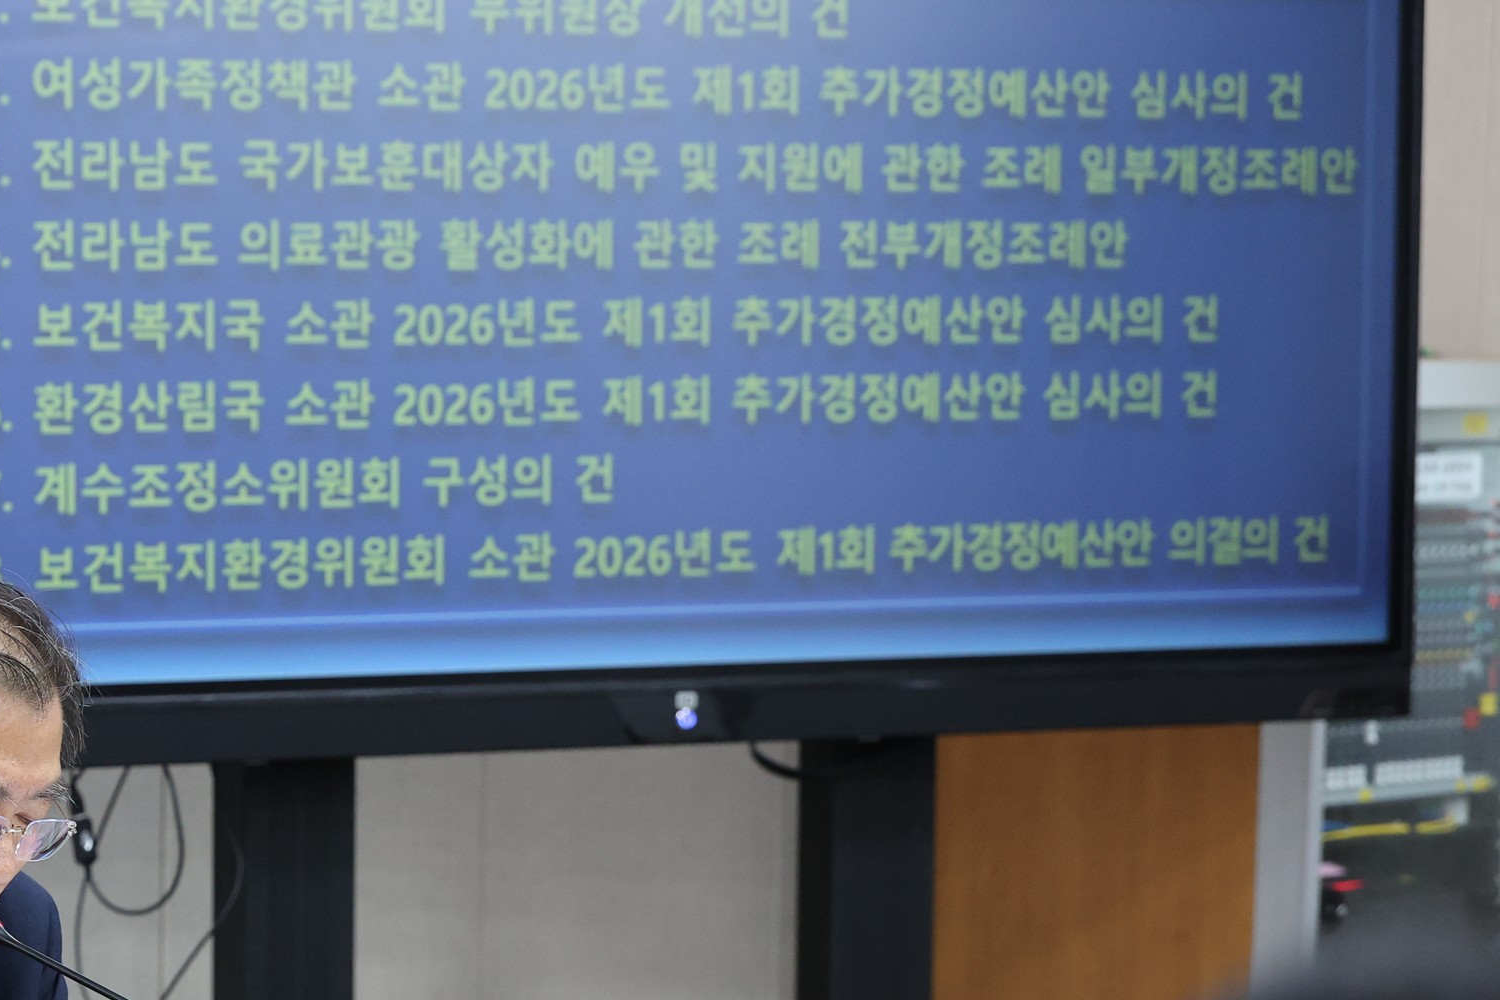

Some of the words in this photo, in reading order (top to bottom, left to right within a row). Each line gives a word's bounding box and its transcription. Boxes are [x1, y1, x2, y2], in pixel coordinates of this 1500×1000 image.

[814, 0, 849, 38] 건
[32, 58, 355, 111] 여성가족정책관
[380, 63, 465, 111] 소관
[486, 65, 669, 113] 2026년도
[695, 66, 799, 114] 제1회
[822, 67, 1111, 118] 추가경정예산안
[1131, 71, 1249, 120] 심사의
[1267, 73, 1303, 121] 건
[32, 138, 217, 191] 전라남도
[240, 139, 553, 191] 국가보훈대상자
[576, 142, 657, 191] 예우
[680, 143, 716, 192] 및
[740, 143, 863, 193] 지원에
[883, 144, 963, 193] 관한
[984, 145, 1062, 193] 조례
[1081, 145, 1358, 196] 일부개정조례안
[33, 219, 218, 272] 전라남도
[239, 220, 419, 271] 의료관광
[442, 219, 614, 271] 활성화에
[635, 220, 719, 269] 관한
[739, 220, 820, 269] 조례
[841, 220, 1129, 270] 전부개정조례안
[33, 299, 265, 352] 보건복지국
[286, 299, 374, 349] 소관
[394, 298, 582, 347] 2026년도
[604, 297, 711, 348] 제1회
[733, 296, 1025, 346] 추가경정예산안
[1045, 295, 1163, 345] 심사의
[1183, 294, 1219, 344] 건
[33, 379, 265, 436] 환경산림국
[286, 379, 376, 430] 소관
[393, 377, 581, 427] 2026년도
[603, 375, 712, 426] 제1회
[732, 372, 1025, 425] 추가경정예산안
[1044, 371, 1162, 422] 심사의
[1182, 370, 1219, 419] 건
[34, 457, 400, 516] 계수조정소위원회
[423, 454, 553, 508] 구성의
[576, 454, 614, 504] 건
[33, 534, 446, 594] 보건복지환경위원회
[468, 531, 556, 584] 소관
[573, 527, 756, 579] 2026년도
[776, 524, 876, 578] 제1회
[888, 519, 1155, 574] 추가경정예산안
[1167, 516, 1280, 567] 의결의
[1294, 515, 1330, 564] 건
